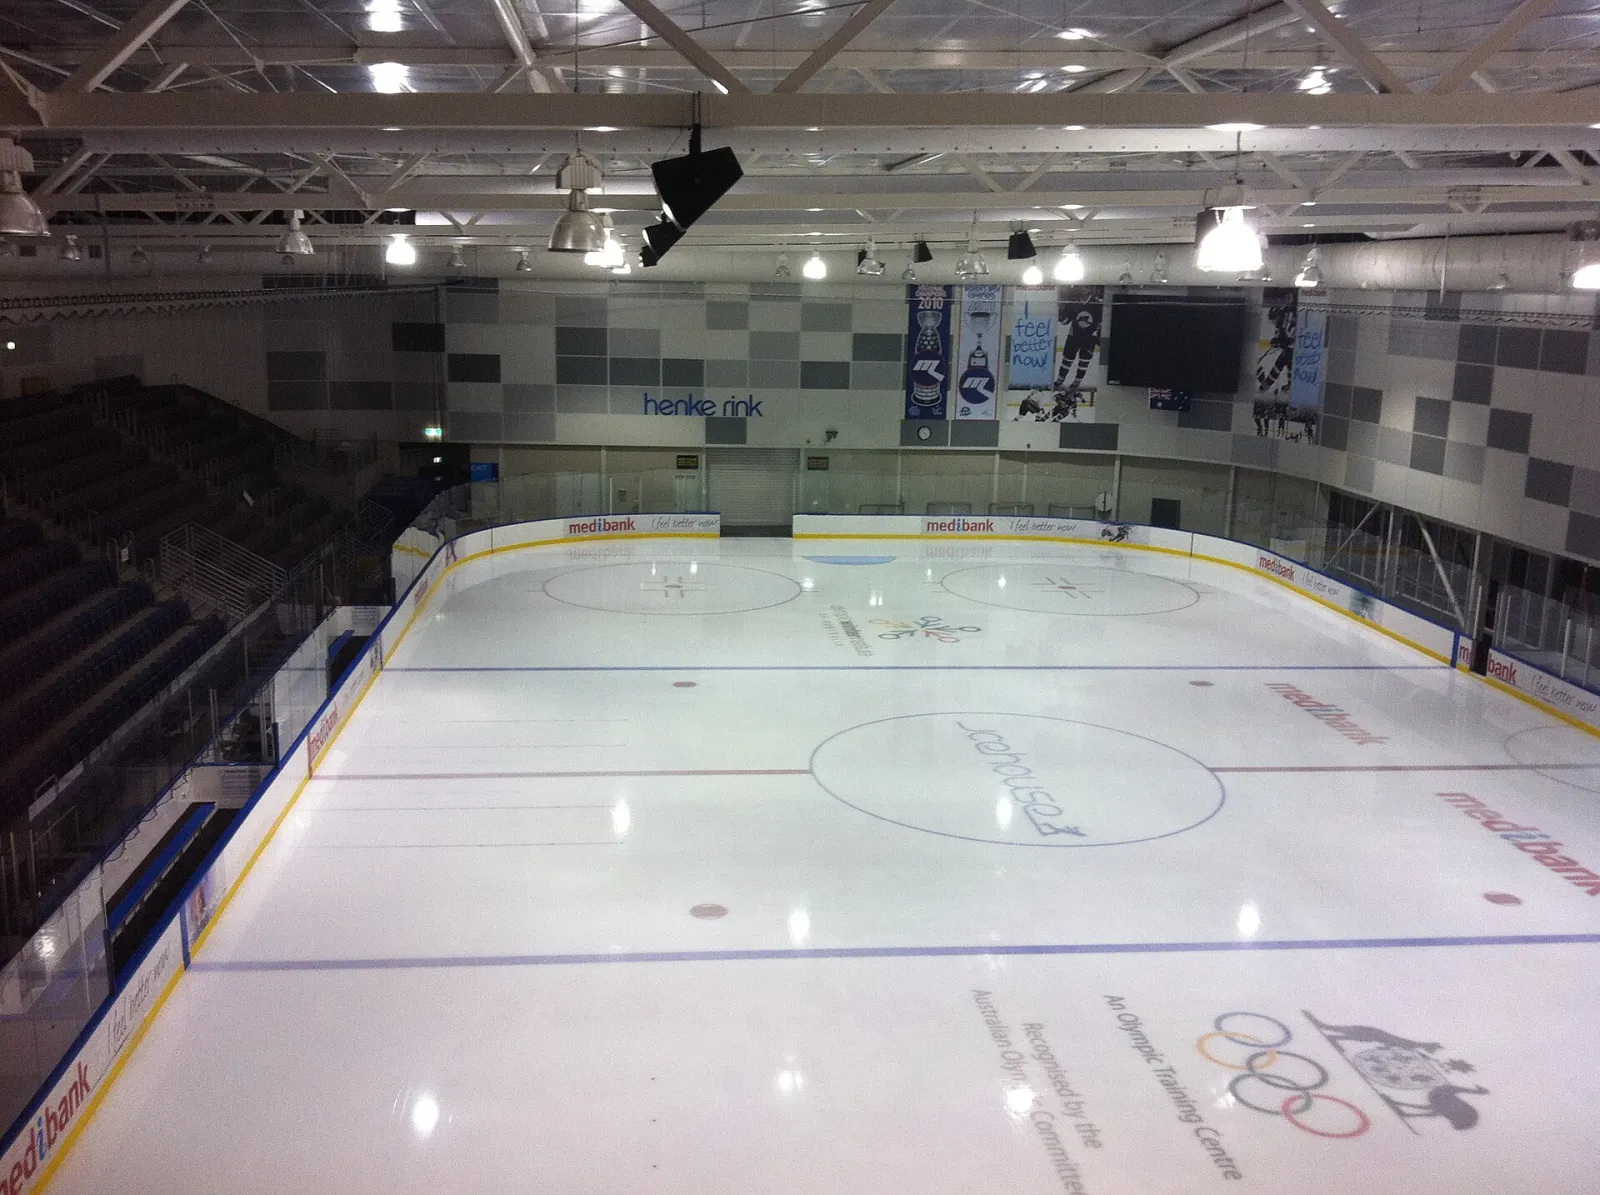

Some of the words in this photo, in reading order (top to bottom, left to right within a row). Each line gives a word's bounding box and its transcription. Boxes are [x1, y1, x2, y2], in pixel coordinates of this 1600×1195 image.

[917, 297, 944, 310] 2010
[1015, 318, 1051, 337] feel
[1012, 339, 1054, 353] better
[643, 392, 717, 417] henke
[723, 394, 764, 417] rink
[569, 516, 636, 534] medibank
[657, 516, 670, 528] feel
[672, 517, 697, 528] better
[698, 519, 719, 528] now
[926, 518, 994, 533] medibank
[1016, 518, 1030, 531] feel
[1031, 521, 1056, 532] better
[1057, 523, 1078, 532] now
[1259, 557, 1295, 581] medibank
[1264, 683, 1391, 745] medibank
[972, 988, 1012, 1048] Australian
[1030, 1110, 1088, 1195] Committe
[1020, 1022, 1082, 1097] Recognised
[1062, 1100, 1086, 1120] by
[1074, 1122, 1103, 1149] the
[1103, 994, 1126, 1011] An
[1116, 1012, 1164, 1064] Olympic
[1153, 1065, 1203, 1124] Training
[1194, 1126, 1243, 1181] Centre
